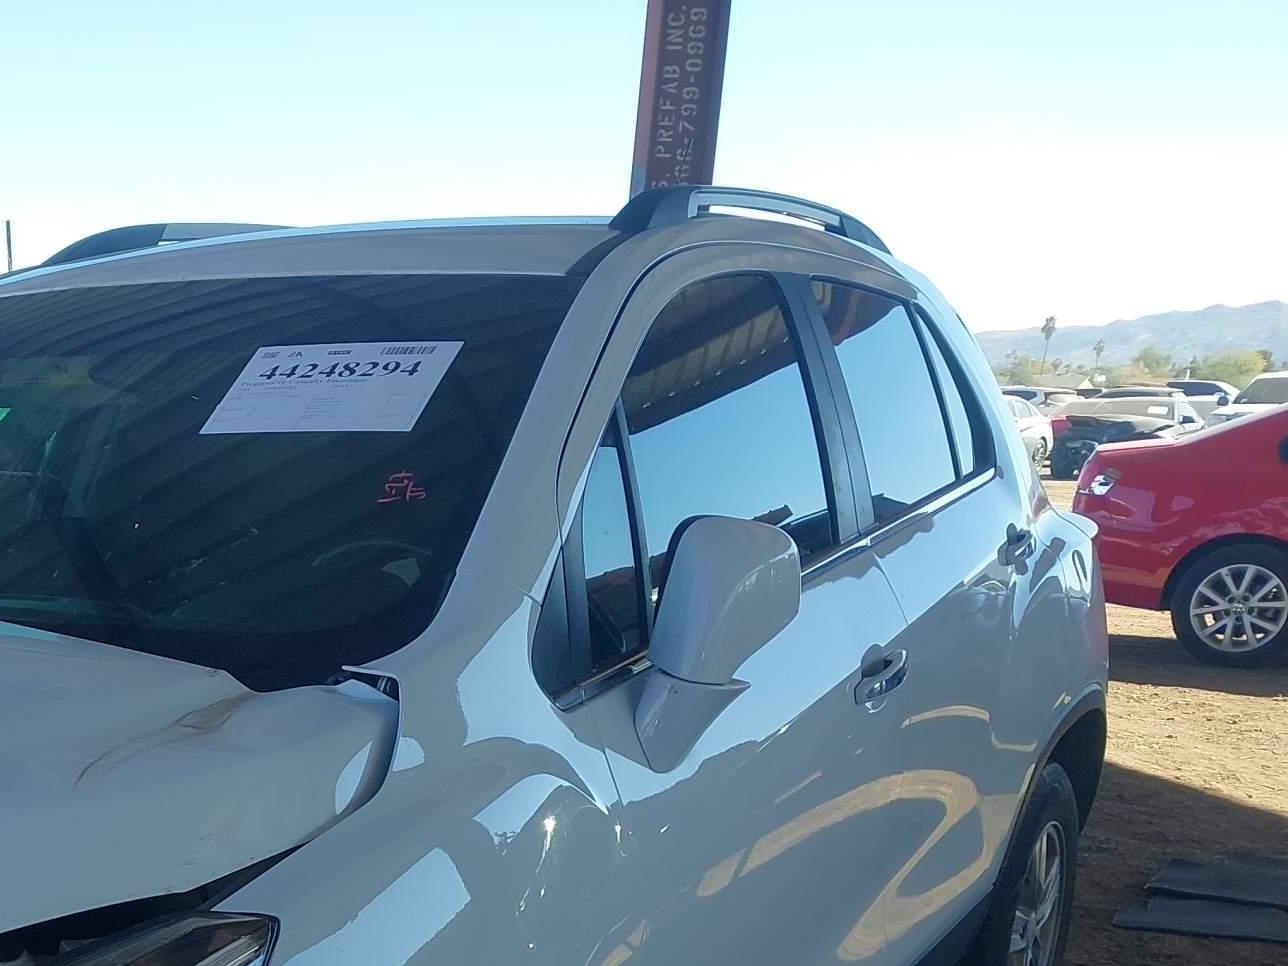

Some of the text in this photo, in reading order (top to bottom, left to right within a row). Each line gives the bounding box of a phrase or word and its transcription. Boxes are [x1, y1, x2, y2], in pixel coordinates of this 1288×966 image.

[665, 5, 687, 50] INC.
[655, 64, 681, 158] PREFAB
[258, 360, 423, 380] 44248294
